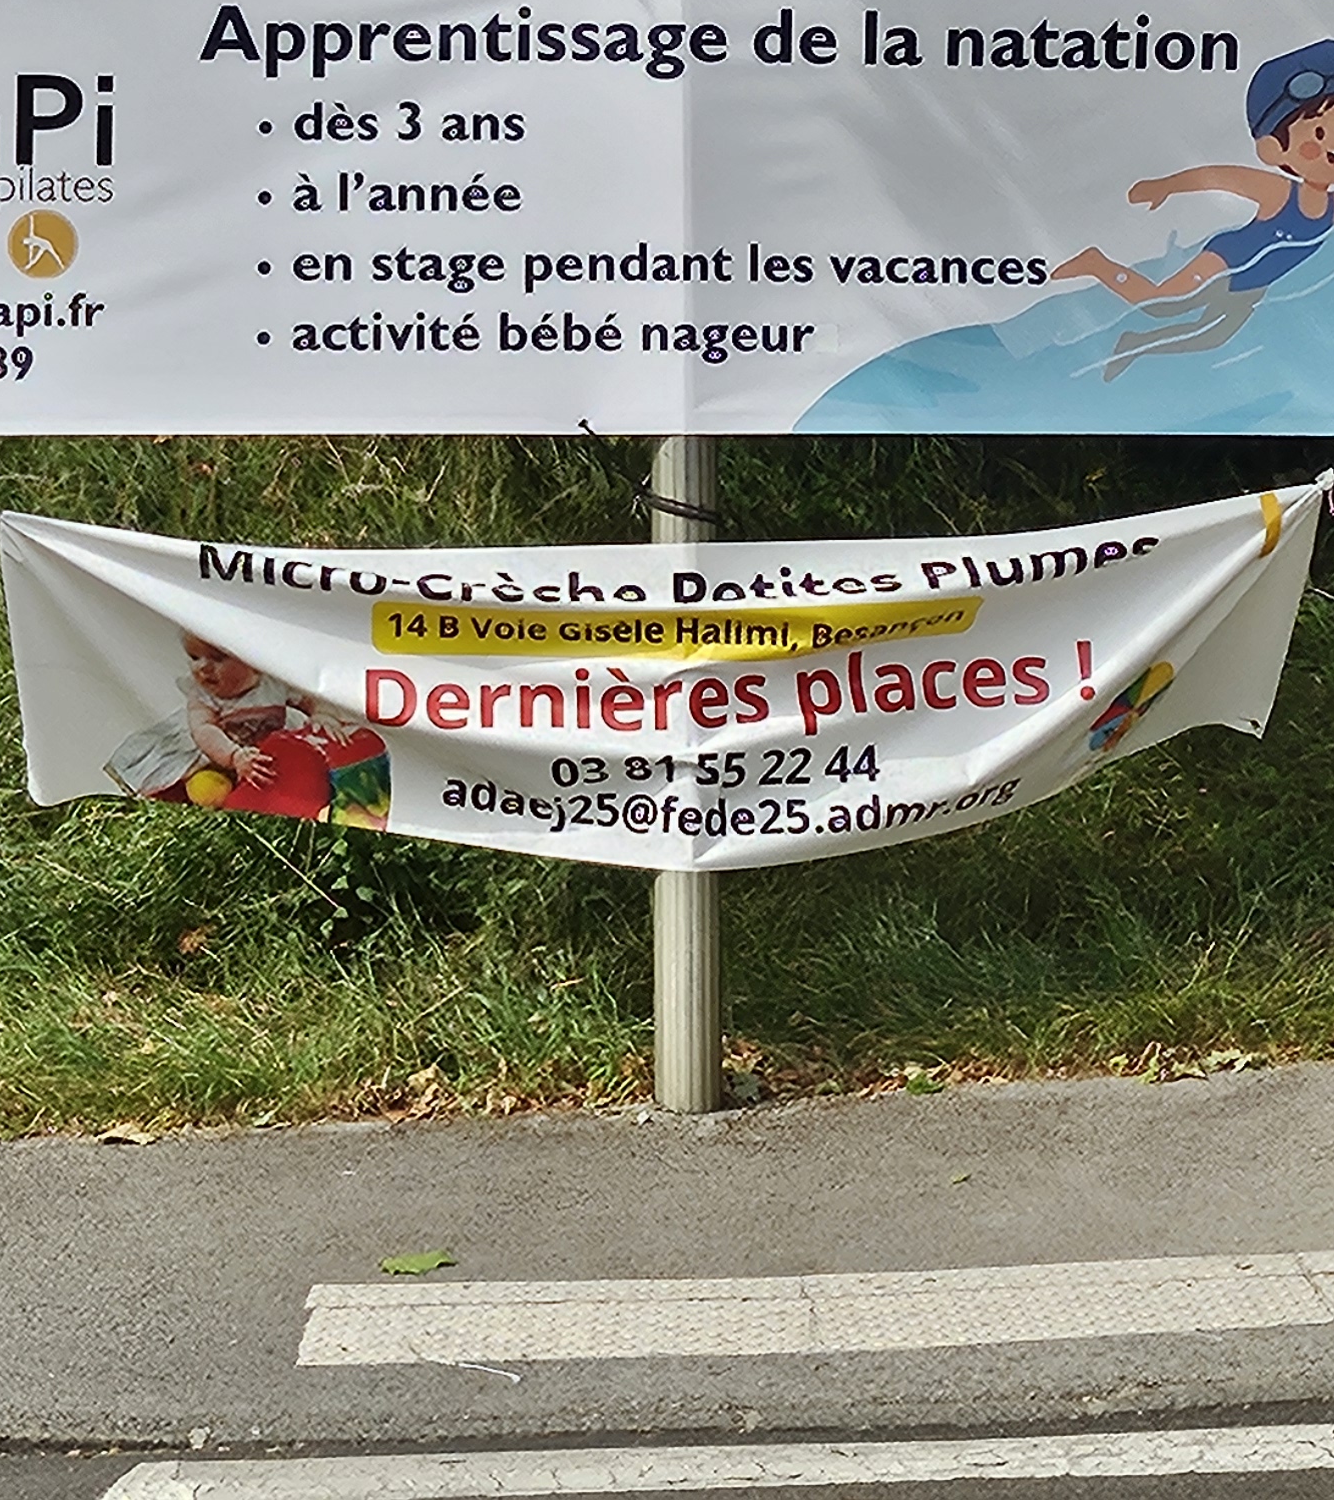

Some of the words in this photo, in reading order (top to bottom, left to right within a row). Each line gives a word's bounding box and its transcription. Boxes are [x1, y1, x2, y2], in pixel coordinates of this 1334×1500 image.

[200, 4, 727, 79] Apprentissage
[753, 8, 838, 65] de
[865, 10, 922, 67] la
[946, 14, 1240, 71] natation
[293, 102, 380, 141] dès
[398, 102, 422, 141] 3
[441, 112, 527, 141] ans
[292, 173, 322, 212] à
[292, 252, 353, 282] en
[372, 247, 506, 293] stage
[525, 242, 735, 294] pendant
[748, 243, 814, 283] les
[828, 254, 1049, 285] vacances
[292, 312, 481, 352] activité
[499, 312, 623, 352] bébé
[642, 321, 815, 364] nageur
[389, 612, 429, 638] 14
[439, 615, 460, 639] B
[471, 617, 547, 642] Voie
[812, 609, 965, 649] Besançon
[365, 667, 769, 731] Dernières
[796, 651, 1051, 736] places
[1076, 640, 1097, 701] !
[551, 756, 609, 787] 03
[624, 754, 675, 783] 81
[695, 751, 747, 788] 55
[758, 748, 811, 785] 22
[825, 743, 880, 782] 44
[441, 776, 1021, 838] adaej25@fede25.admr.org
